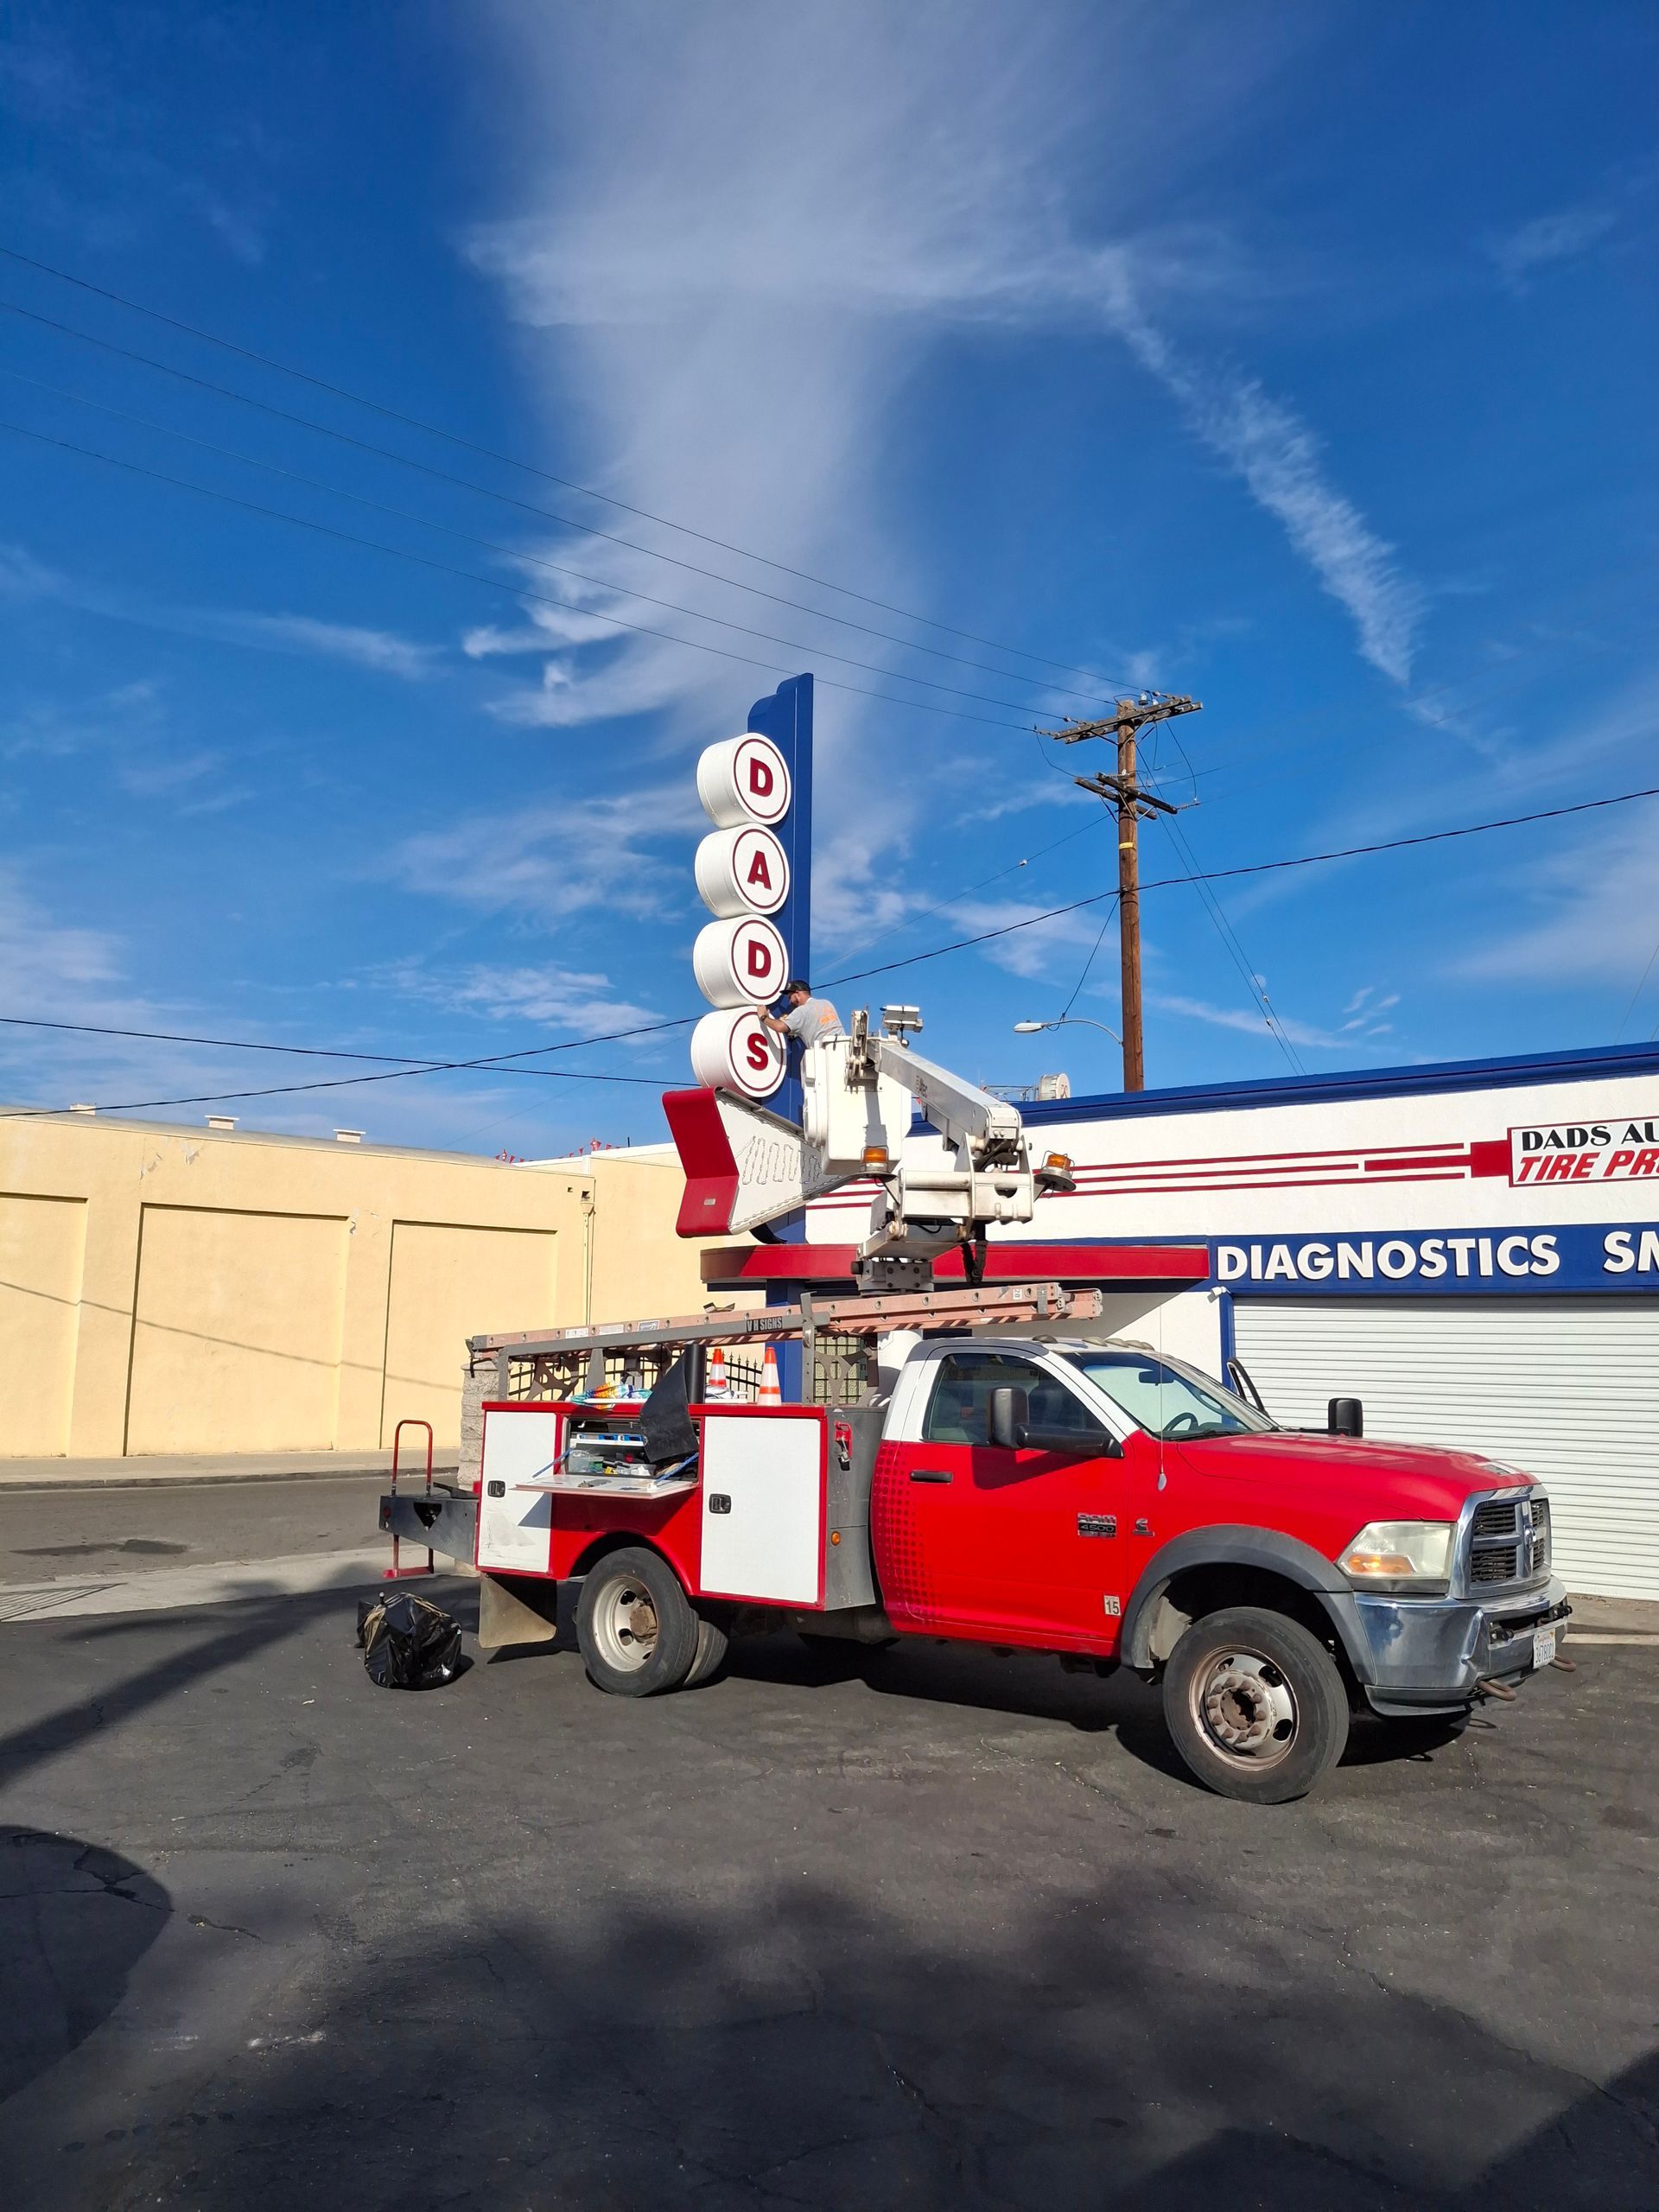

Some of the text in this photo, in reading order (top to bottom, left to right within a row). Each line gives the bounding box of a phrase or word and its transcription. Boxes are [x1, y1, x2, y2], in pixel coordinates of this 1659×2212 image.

[1522, 1125, 1611, 1151] DADS
[1516, 1147, 1659, 1182] TIRE PR
[1217, 1235, 1560, 1280] DIAGNOSTICS
[760, 1317, 783, 1331] SIGNS
[1080, 1523, 1115, 1532] 4500
[1106, 1600, 1120, 1615] 15
